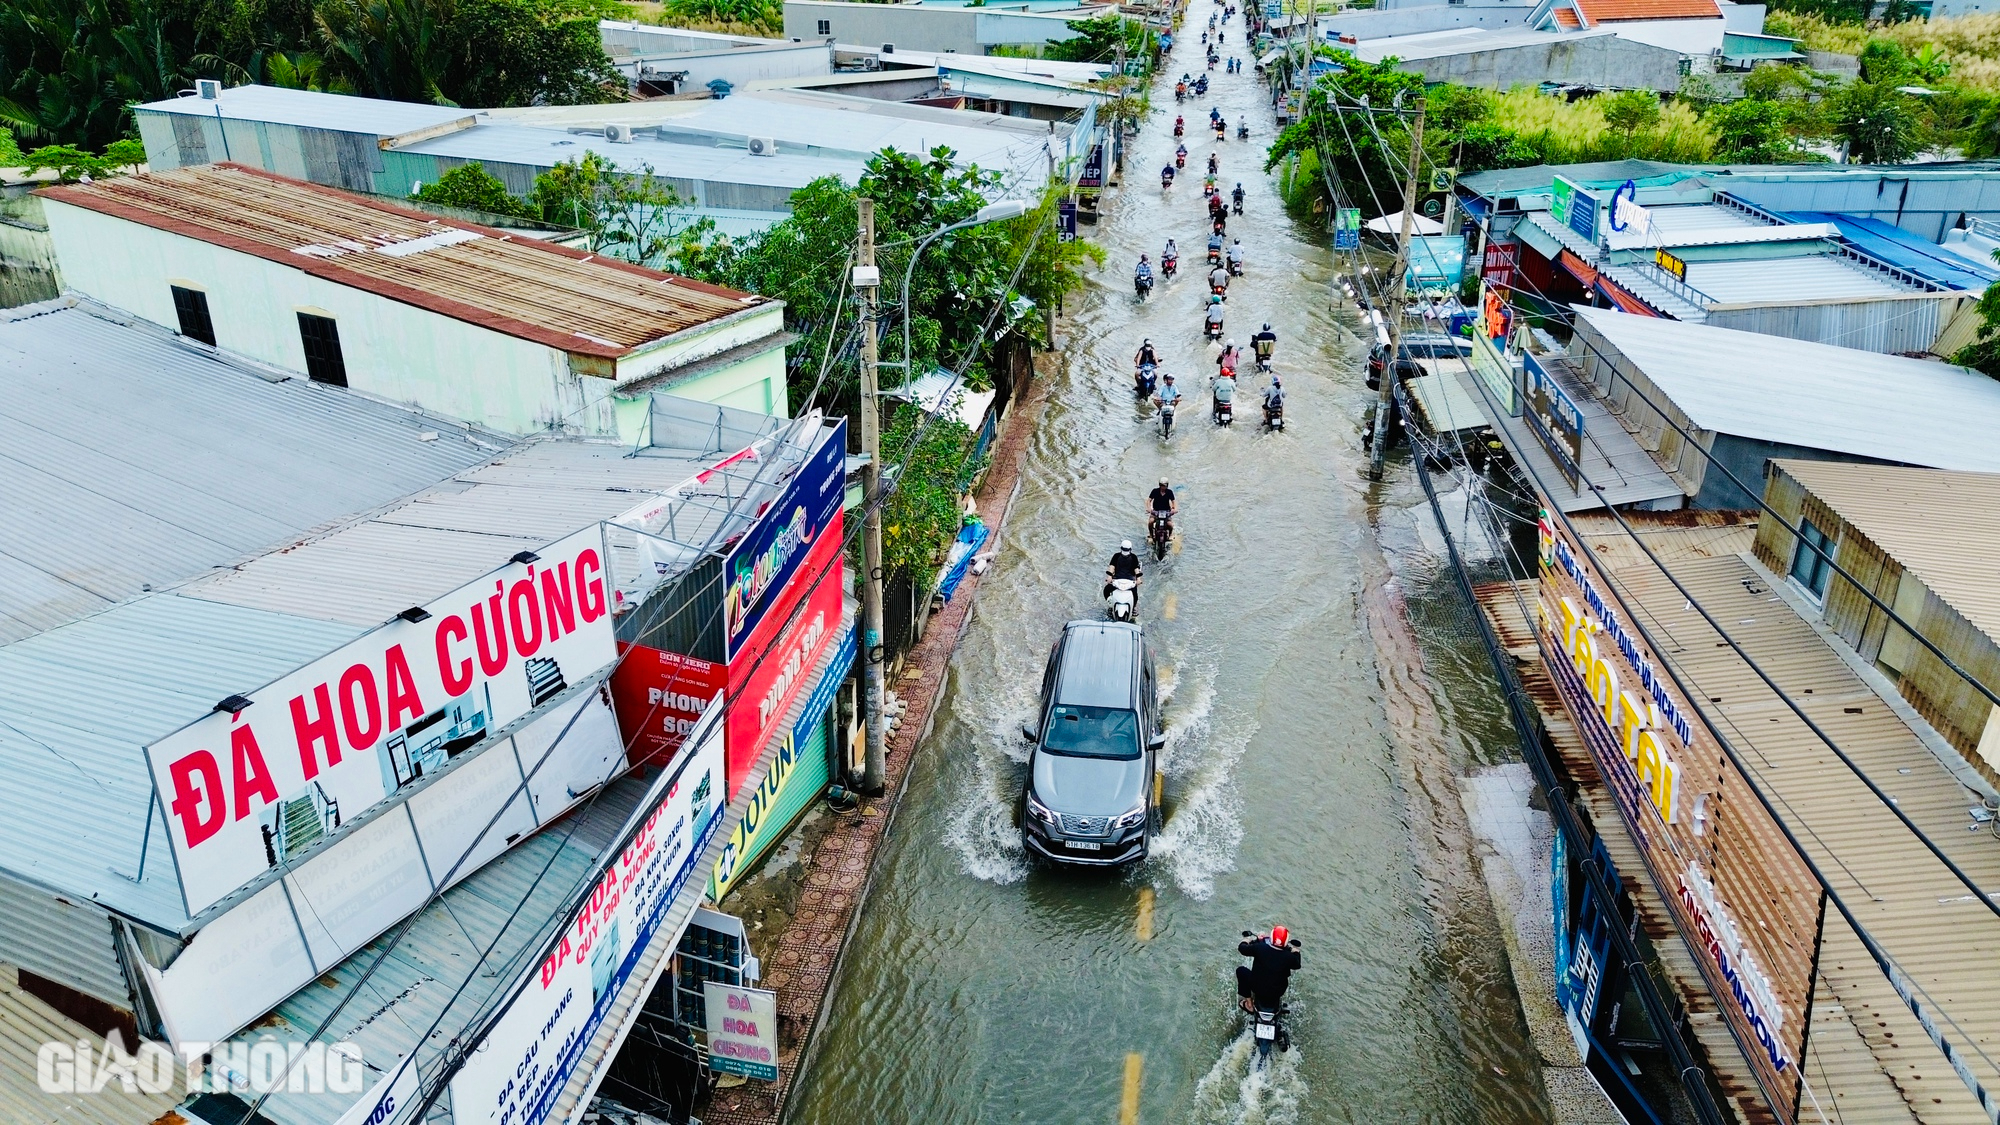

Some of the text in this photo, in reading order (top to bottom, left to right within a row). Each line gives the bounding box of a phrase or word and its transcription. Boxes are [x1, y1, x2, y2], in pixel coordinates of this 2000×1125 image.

[759, 648, 801, 730] PHONG
[1558, 540, 1693, 749] CÔNG TY TNHH XÂY DỰNG VÀ DỊCH VỤ
[170, 548, 607, 849] ĐÁ HOA CƯƠNG
[648, 687, 712, 715] PHON
[738, 736, 792, 854] JOTUN
[1620, 690, 1680, 824] TÀI
[578, 865, 617, 938] HOA
[498, 1075, 515, 1108] ĐÁ
[540, 987, 573, 1042] THANG
[723, 1017, 759, 1038] HOA
[727, 993, 752, 1013] ĐÁ
[518, 1063, 539, 1102] BẾP
[520, 1064, 554, 1123] THANG
[556, 1025, 577, 1067] MÁY
